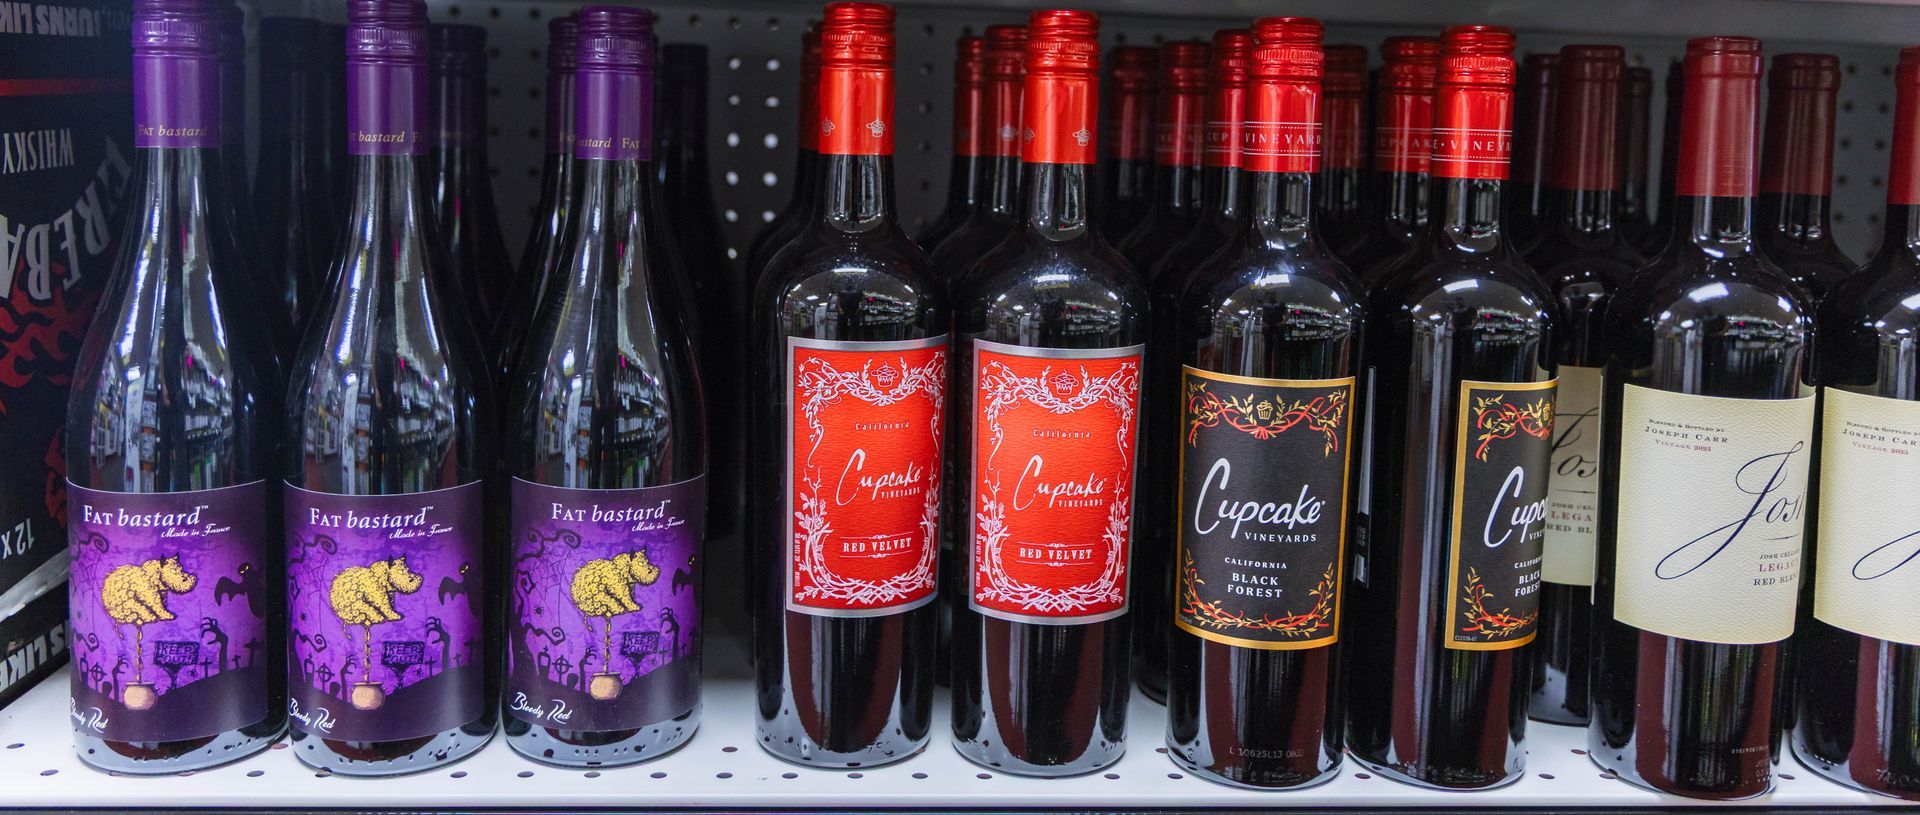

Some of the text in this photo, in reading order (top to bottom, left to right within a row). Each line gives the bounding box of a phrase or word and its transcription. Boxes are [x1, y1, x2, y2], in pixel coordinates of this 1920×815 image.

[158, 124, 207, 137] bastard
[358, 130, 405, 143] bastard
[622, 137, 640, 149] FAT
[1245, 132, 1322, 145] VINEYARD
[2, 127, 75, 174] WHISKY
[855, 422, 909, 431] California
[1033, 429, 1091, 439] California
[1644, 426, 1728, 443] JOSEPH CARR
[1842, 428, 1920, 446] JOSEPH CAR
[836, 448, 921, 506] Cupcake
[1013, 454, 1104, 511] Cupcake
[881, 486, 920, 499] VINEYARDS
[1194, 457, 1321, 539] Cupcake
[1059, 499, 1103, 508] VINEYARDS
[83, 503, 112, 526] FAT
[310, 507, 341, 528] FAT
[552, 503, 586, 522] FAT
[1551, 510, 1593, 522] LEGA
[161, 523, 230, 538] Made in France
[389, 523, 453, 539] Made in France
[632, 520, 655, 532] Made
[656, 522, 664, 530] in
[1546, 522, 1572, 532] RED
[15, 518, 35, 556] 12
[1244, 531, 1317, 543] VINEYARDS
[843, 537, 912, 553] RED VELVET
[1019, 547, 1093, 560] RED VELVET
[1224, 557, 1287, 569] CALIFORNIA
[1232, 572, 1279, 586] BLACK
[1753, 577, 1776, 586] RED
[1227, 584, 1283, 598] FOREST
[629, 635, 654, 645] KEEP
[161, 644, 192, 655] KEEP
[389, 644, 418, 655] KEEP
[510, 692, 573, 725] Bloody Red
[88, 706, 109, 733] Red
[289, 698, 336, 733] Bloody Red
